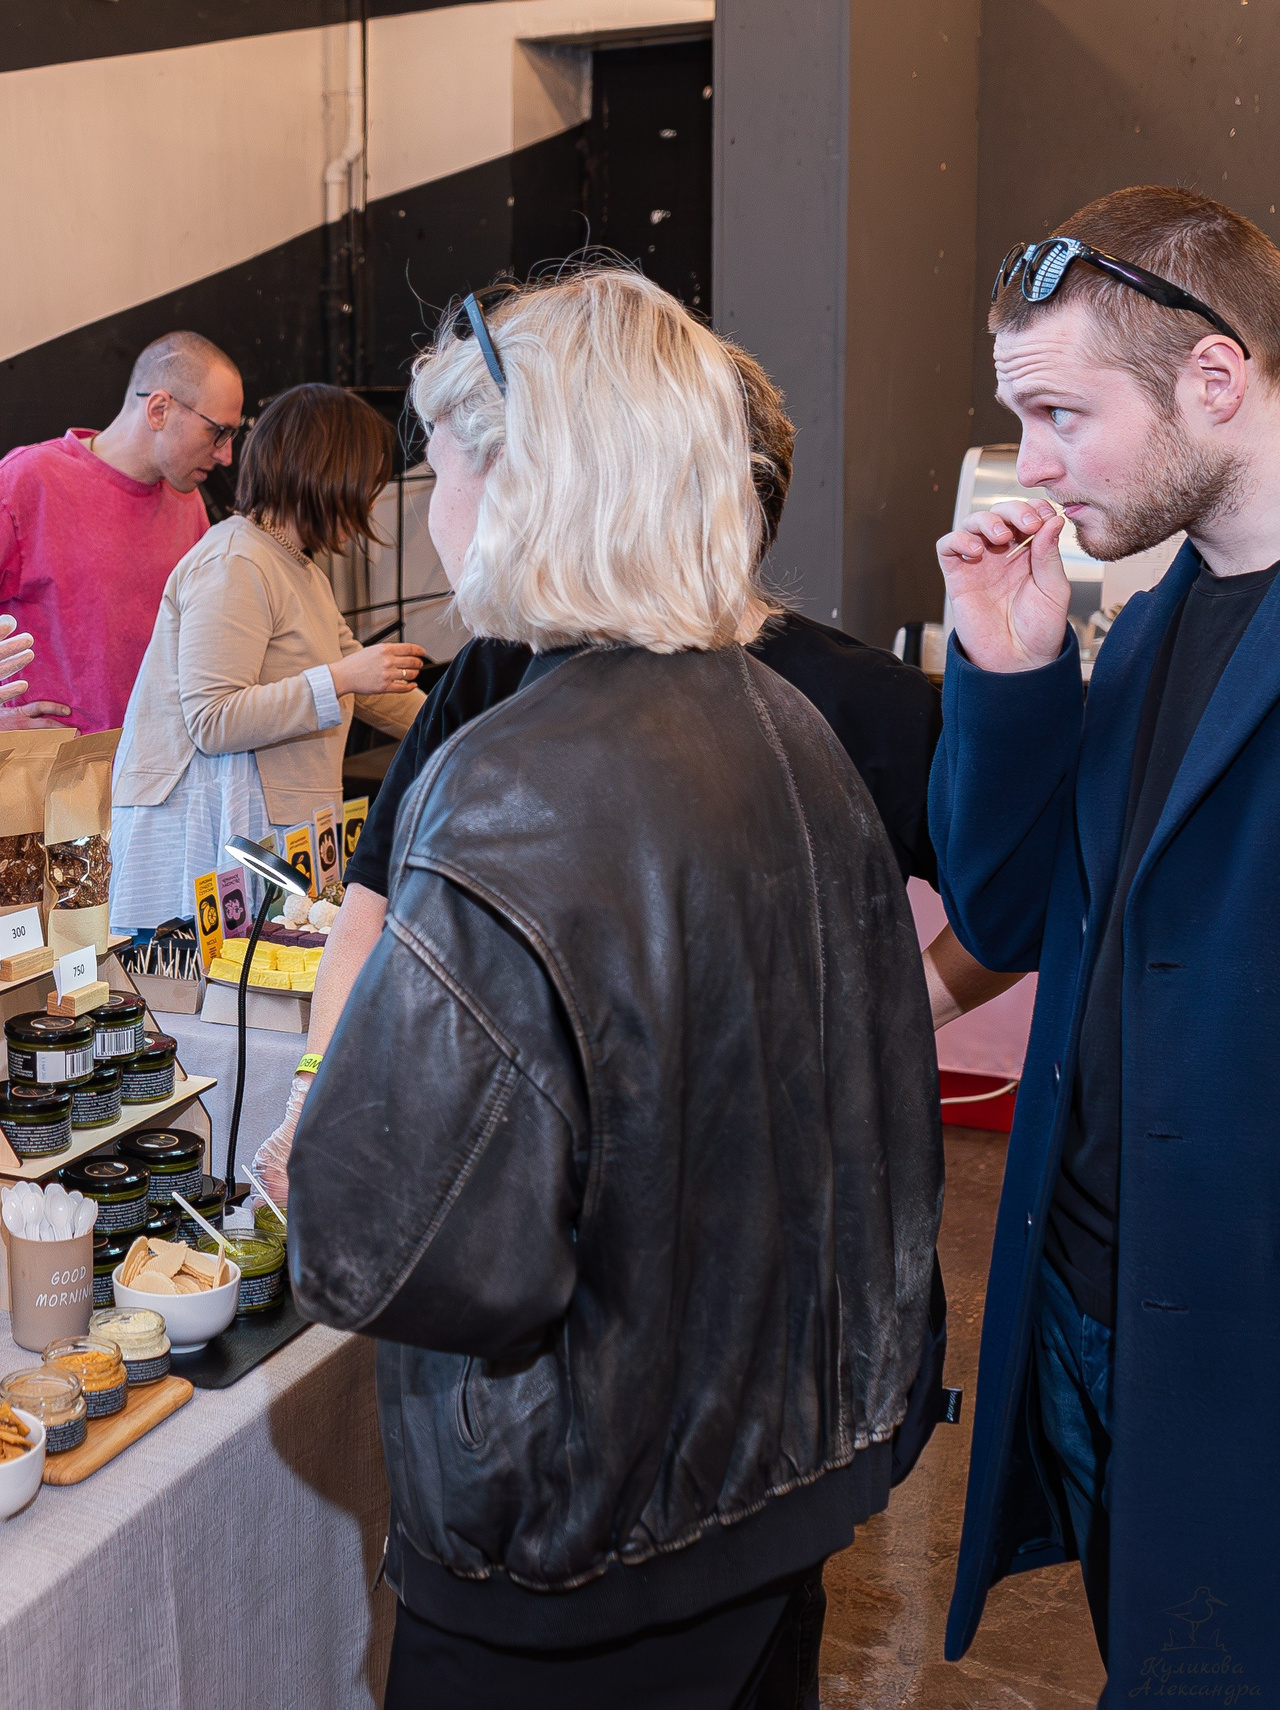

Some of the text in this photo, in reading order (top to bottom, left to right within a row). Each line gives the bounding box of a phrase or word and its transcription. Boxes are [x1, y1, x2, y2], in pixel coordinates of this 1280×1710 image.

[11, 925, 26, 939] 300
[72, 963, 85, 978] 750
[51, 1266, 86, 1286] GOOD
